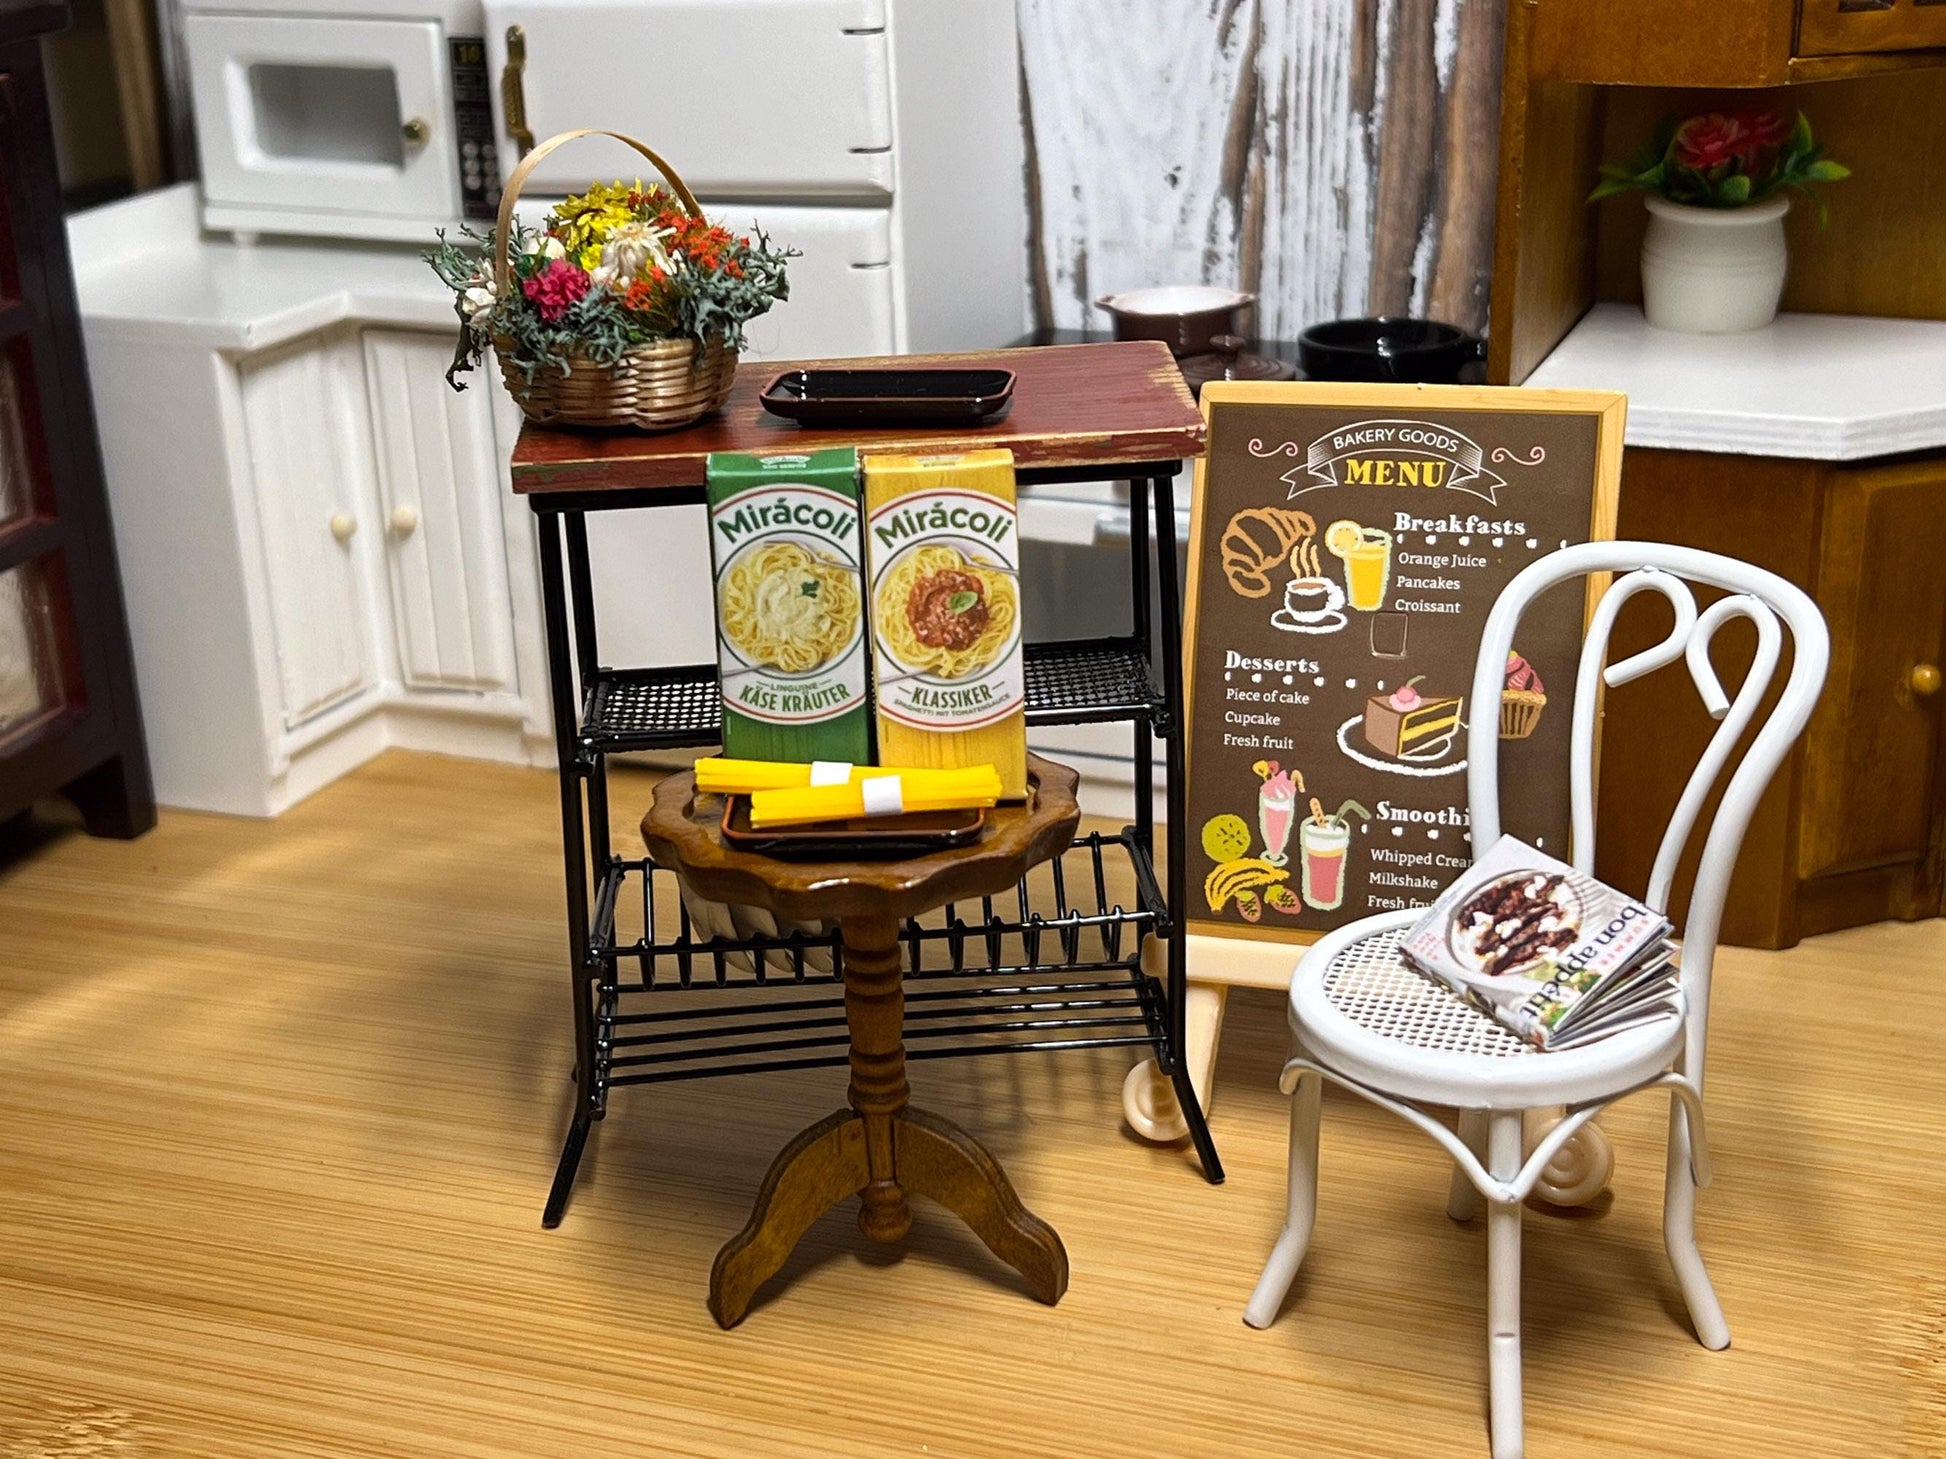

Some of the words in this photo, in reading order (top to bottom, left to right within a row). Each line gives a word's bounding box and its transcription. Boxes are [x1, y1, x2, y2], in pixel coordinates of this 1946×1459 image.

[1333, 428, 1396, 450] BAKERY
[1398, 428, 1460, 453] GOODS
[1344, 458, 1447, 488] MENU
[717, 497, 857, 544] Mirácoli
[874, 502, 1013, 549] Mirácoli
[1393, 511, 1526, 536] Breakfasts
[1398, 552, 1449, 569] Orange
[1450, 554, 1487, 568] Juice
[1396, 575, 1461, 590] Pancakes
[1394, 598, 1461, 614] Croissant
[1224, 650, 1320, 674] Desserts
[739, 685, 778, 710] KÄSE
[782, 683, 850, 712] KRÄUTER
[770, 683, 818, 693] LINGUINE
[911, 684, 993, 709] KLASSIKER
[1226, 687, 1260, 701] Piece
[1263, 689, 1278, 703] of
[1279, 691, 1310, 705] cake
[1224, 710, 1281, 727] Cupcake
[1223, 733, 1260, 748] Fresh
[1262, 735, 1294, 750] fruit
[1370, 848, 1432, 867] Whipped
[1368, 871, 1438, 889] Milkshake
[1367, 895, 1405, 909] Fresh
[1593, 905, 1648, 946] bon
[1519, 945, 1598, 1017] appétit
